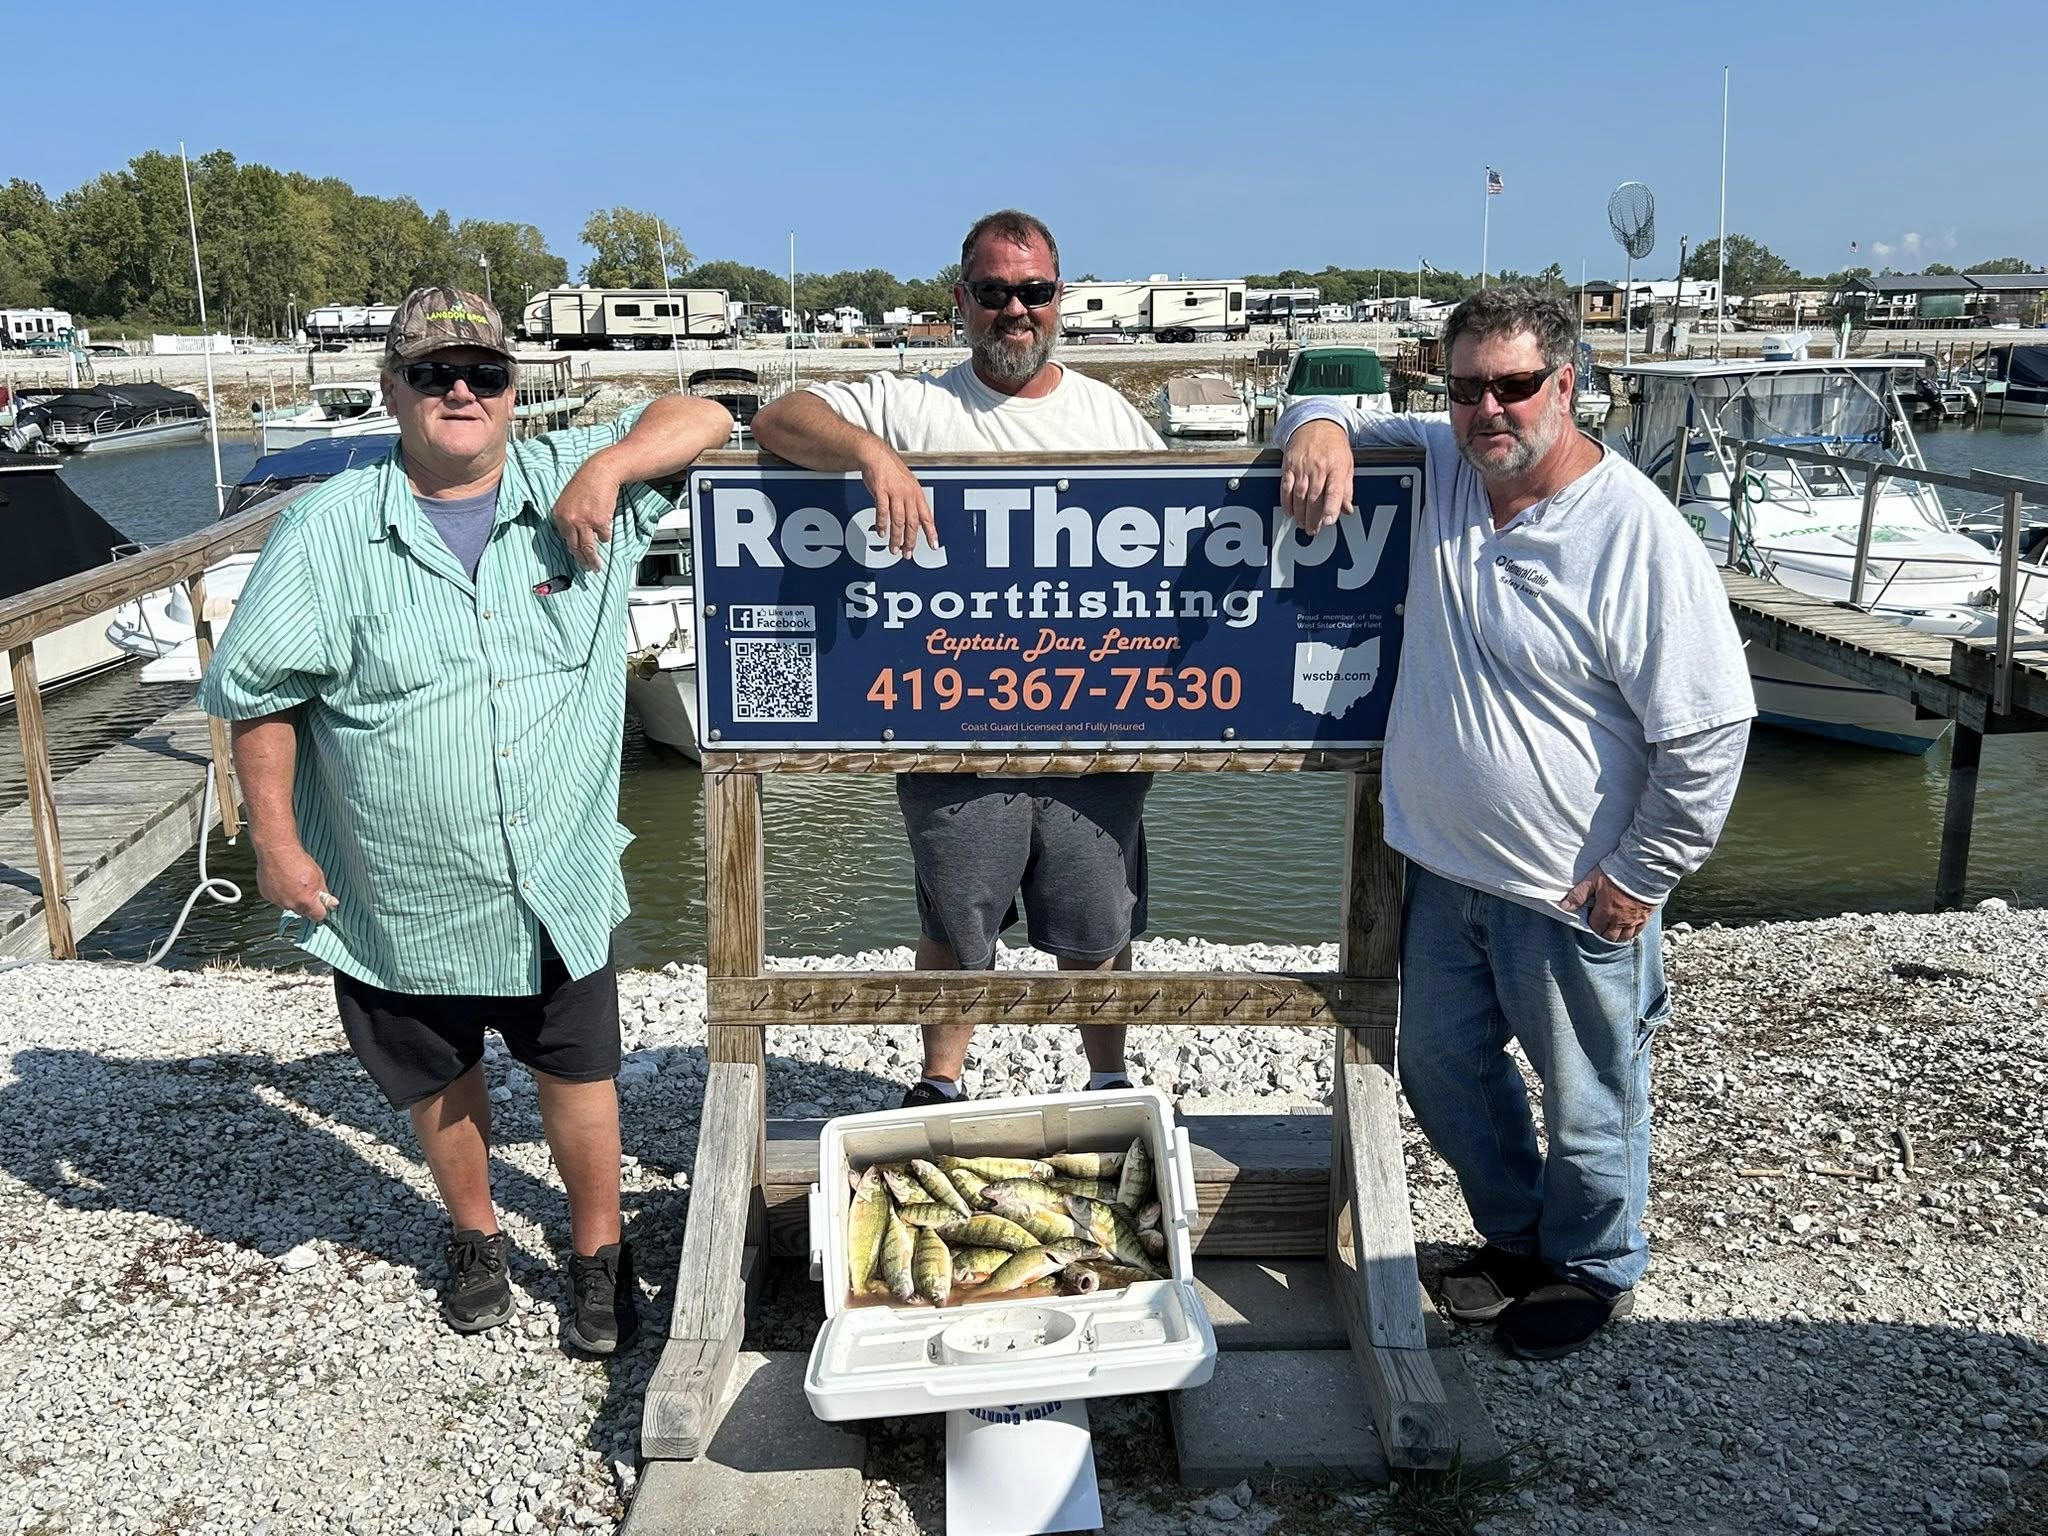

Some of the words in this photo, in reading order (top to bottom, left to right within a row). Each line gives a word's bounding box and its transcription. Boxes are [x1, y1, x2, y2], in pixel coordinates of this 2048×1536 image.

[426, 311, 466, 321] LANGDON
[964, 486, 1398, 591] Therapy
[1505, 559, 1532, 579] General
[1527, 569, 1548, 587] Cable
[845, 580, 1263, 629] Sportfishing
[757, 617, 811, 628] Facebook
[1316, 621, 1335, 629] Sister
[1336, 621, 1361, 629] Charter
[1363, 621, 1382, 629] Fleet
[926, 627, 1020, 661] Captain
[1022, 628, 1085, 663] Dan
[1088, 627, 1181, 663] Lemon
[1302, 670, 1371, 681] wscba.com
[866, 666, 1242, 711] 419-367-7530
[960, 722, 988, 731] Coast
[990, 722, 1018, 731] Guard
[1020, 722, 1063, 731] Licensed
[1065, 722, 1083, 731] and
[1085, 722, 1107, 733] Fully
[1109, 722, 1145, 732] Insured
